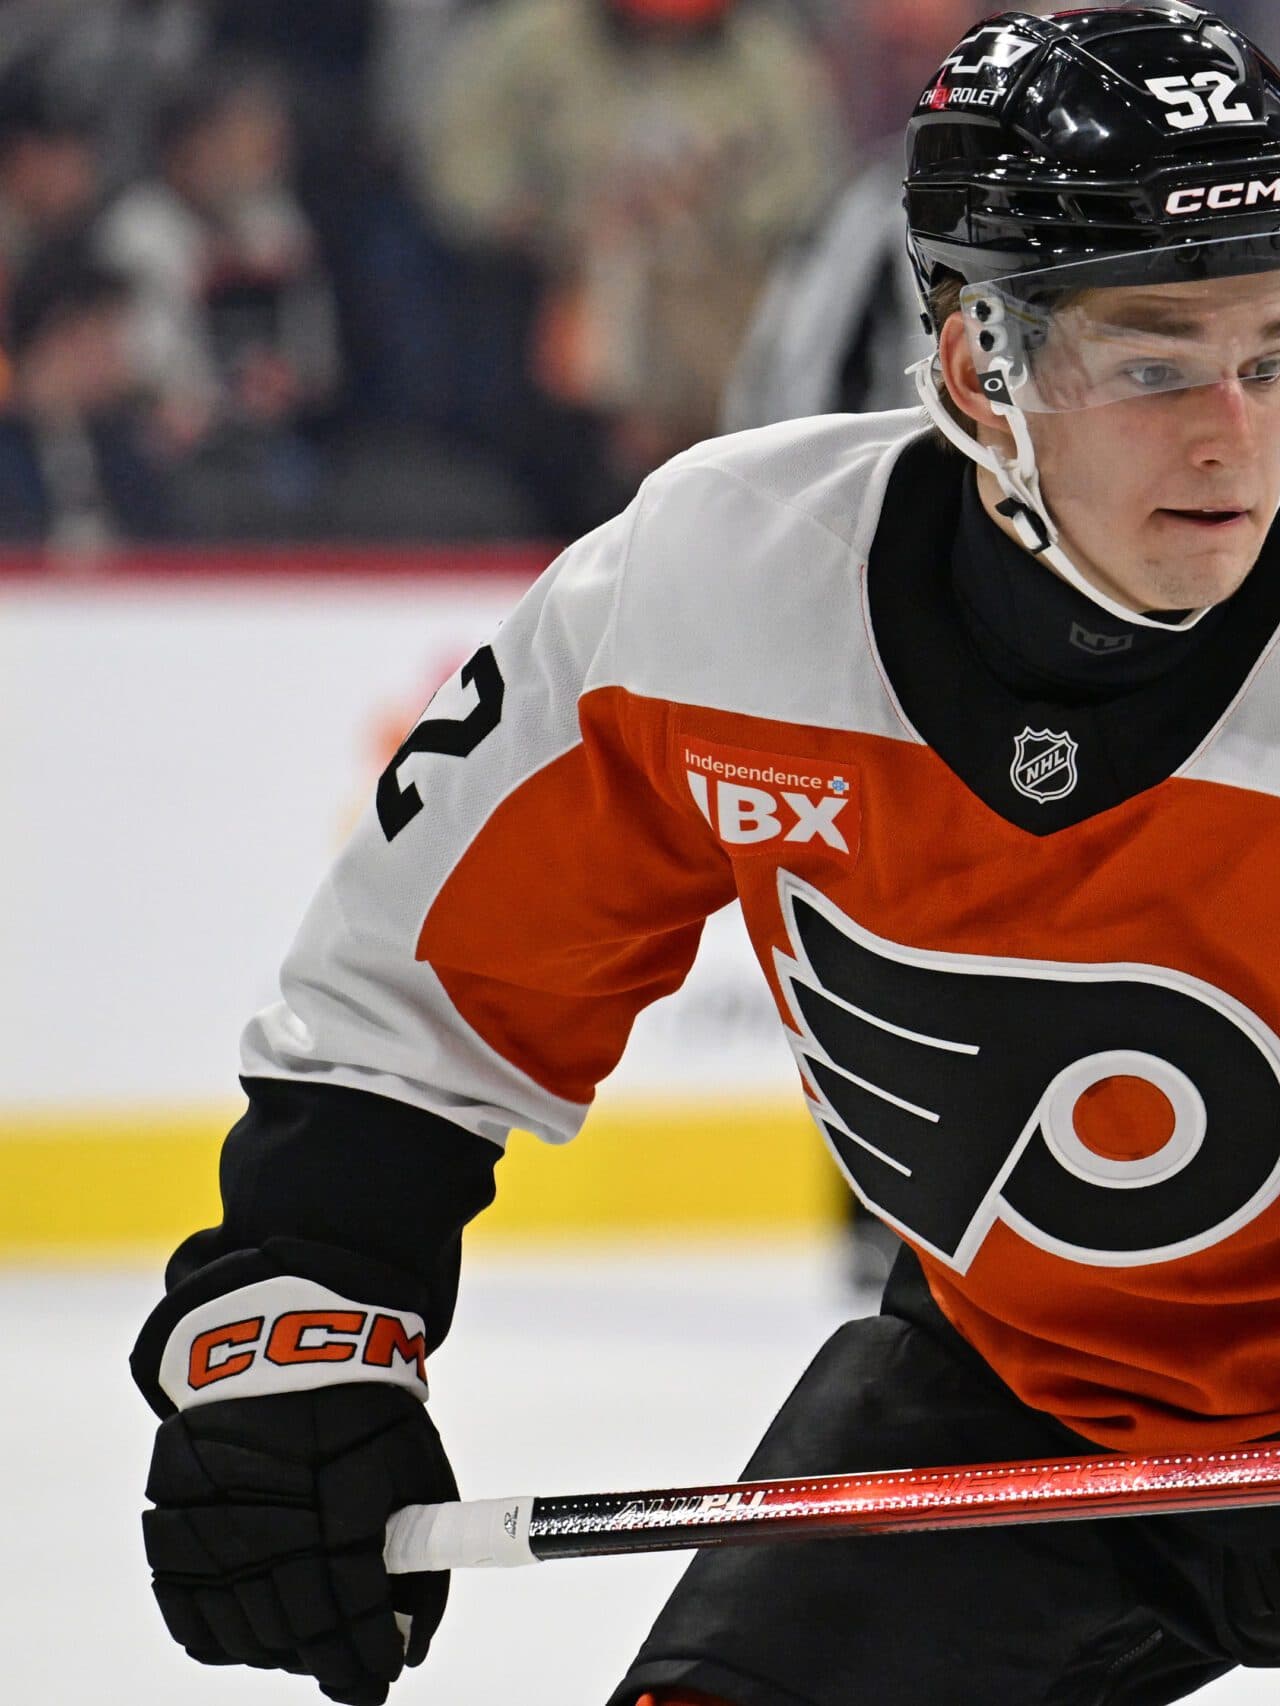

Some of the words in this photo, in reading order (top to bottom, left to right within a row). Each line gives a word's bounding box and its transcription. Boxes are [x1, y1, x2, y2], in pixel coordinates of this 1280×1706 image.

[919, 87, 1007, 107] CHEVROLET
[1144, 70, 1254, 131] 52
[684, 748, 823, 790] Independence
[1026, 750, 1065, 785] NHL
[686, 769, 850, 855] IBX
[187, 1309, 428, 1391] CCM
